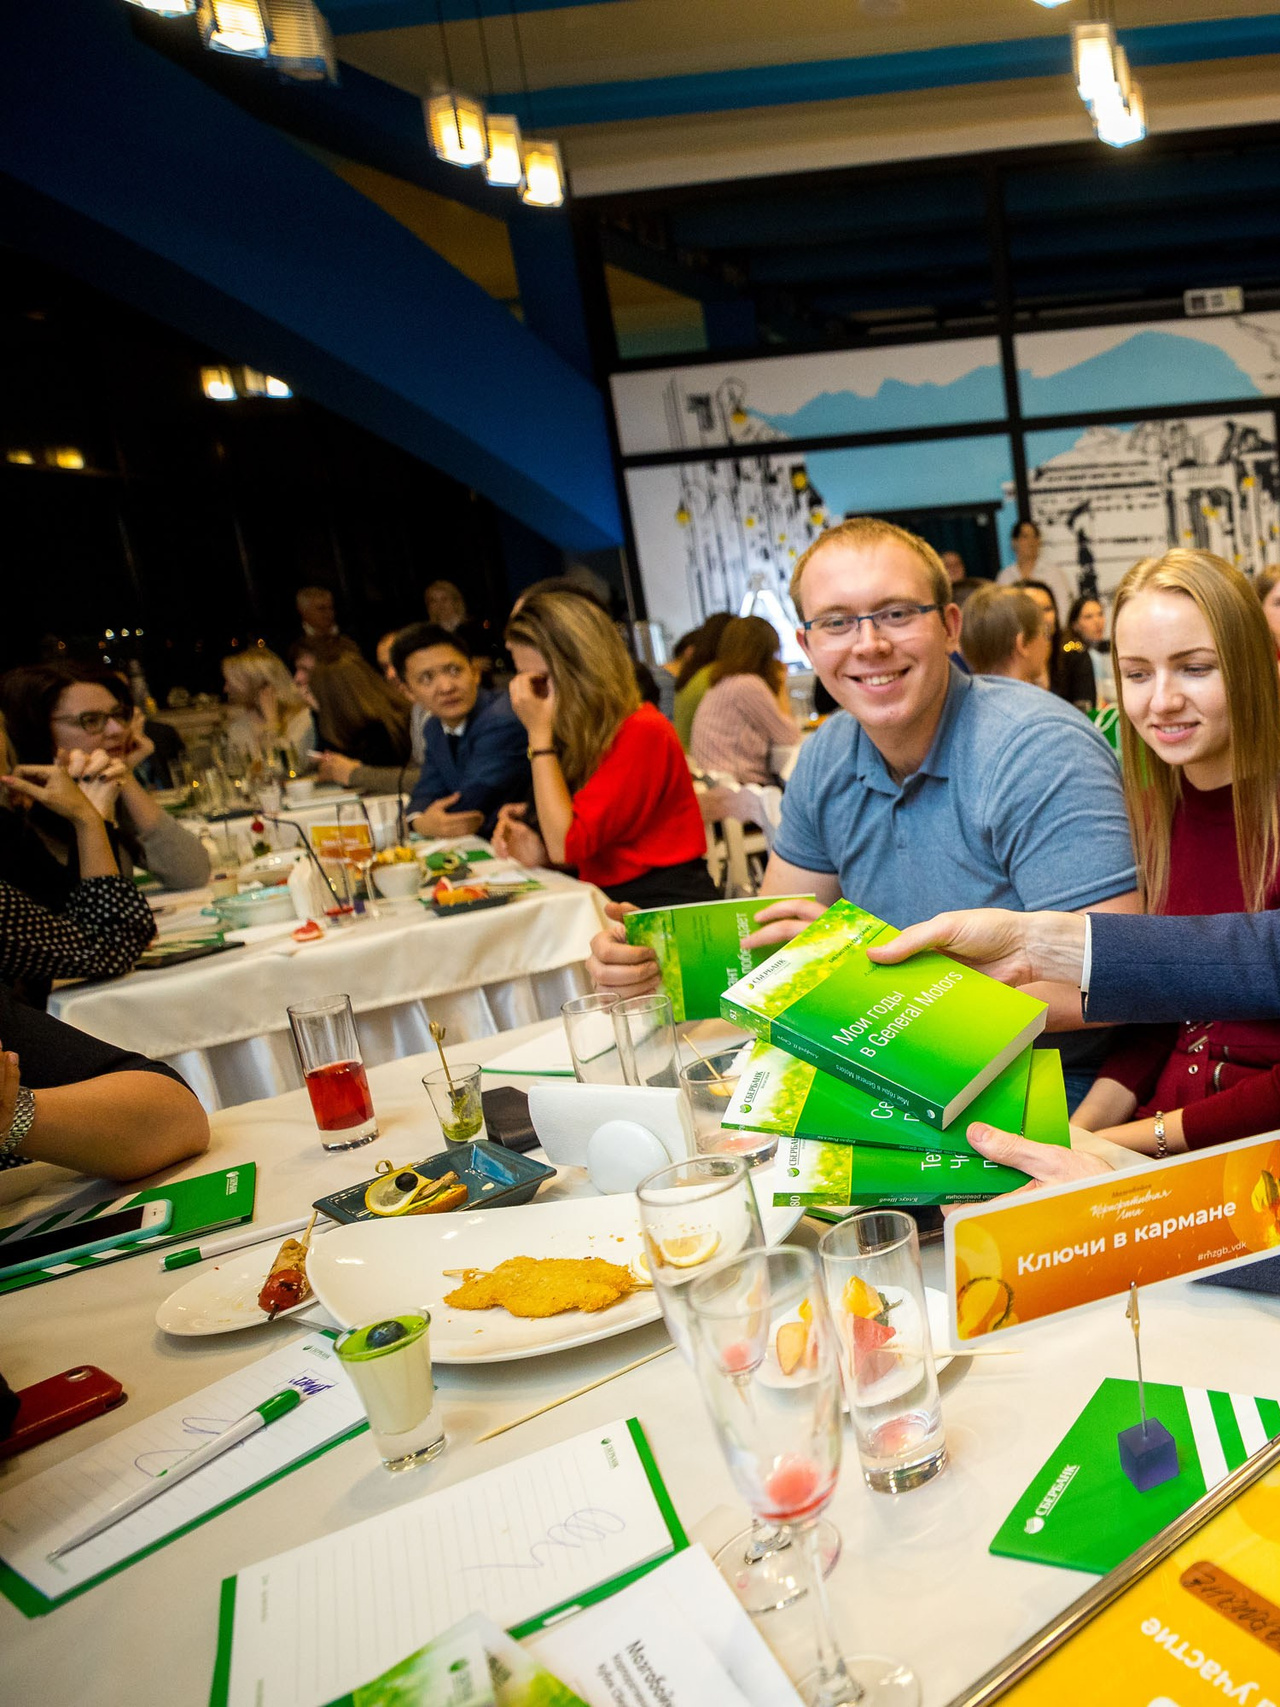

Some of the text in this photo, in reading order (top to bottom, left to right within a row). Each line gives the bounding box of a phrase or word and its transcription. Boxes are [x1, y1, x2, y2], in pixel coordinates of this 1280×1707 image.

[736, 912, 753, 974] победает
[751, 956, 785, 984] СБЕРБАНК
[832, 990, 906, 1045] Мои годы
[859, 971, 963, 1057] в General Motors
[743, 1071, 764, 1103] СБЕРБАНК
[834, 1064, 855, 1078] Motors
[853, 1074, 876, 1089] General
[1017, 1200, 1237, 1275] Ключи в кармане
[1035, 1464, 1078, 1516] СБЕРБАНК
[1141, 1617, 1260, 1706] участие
